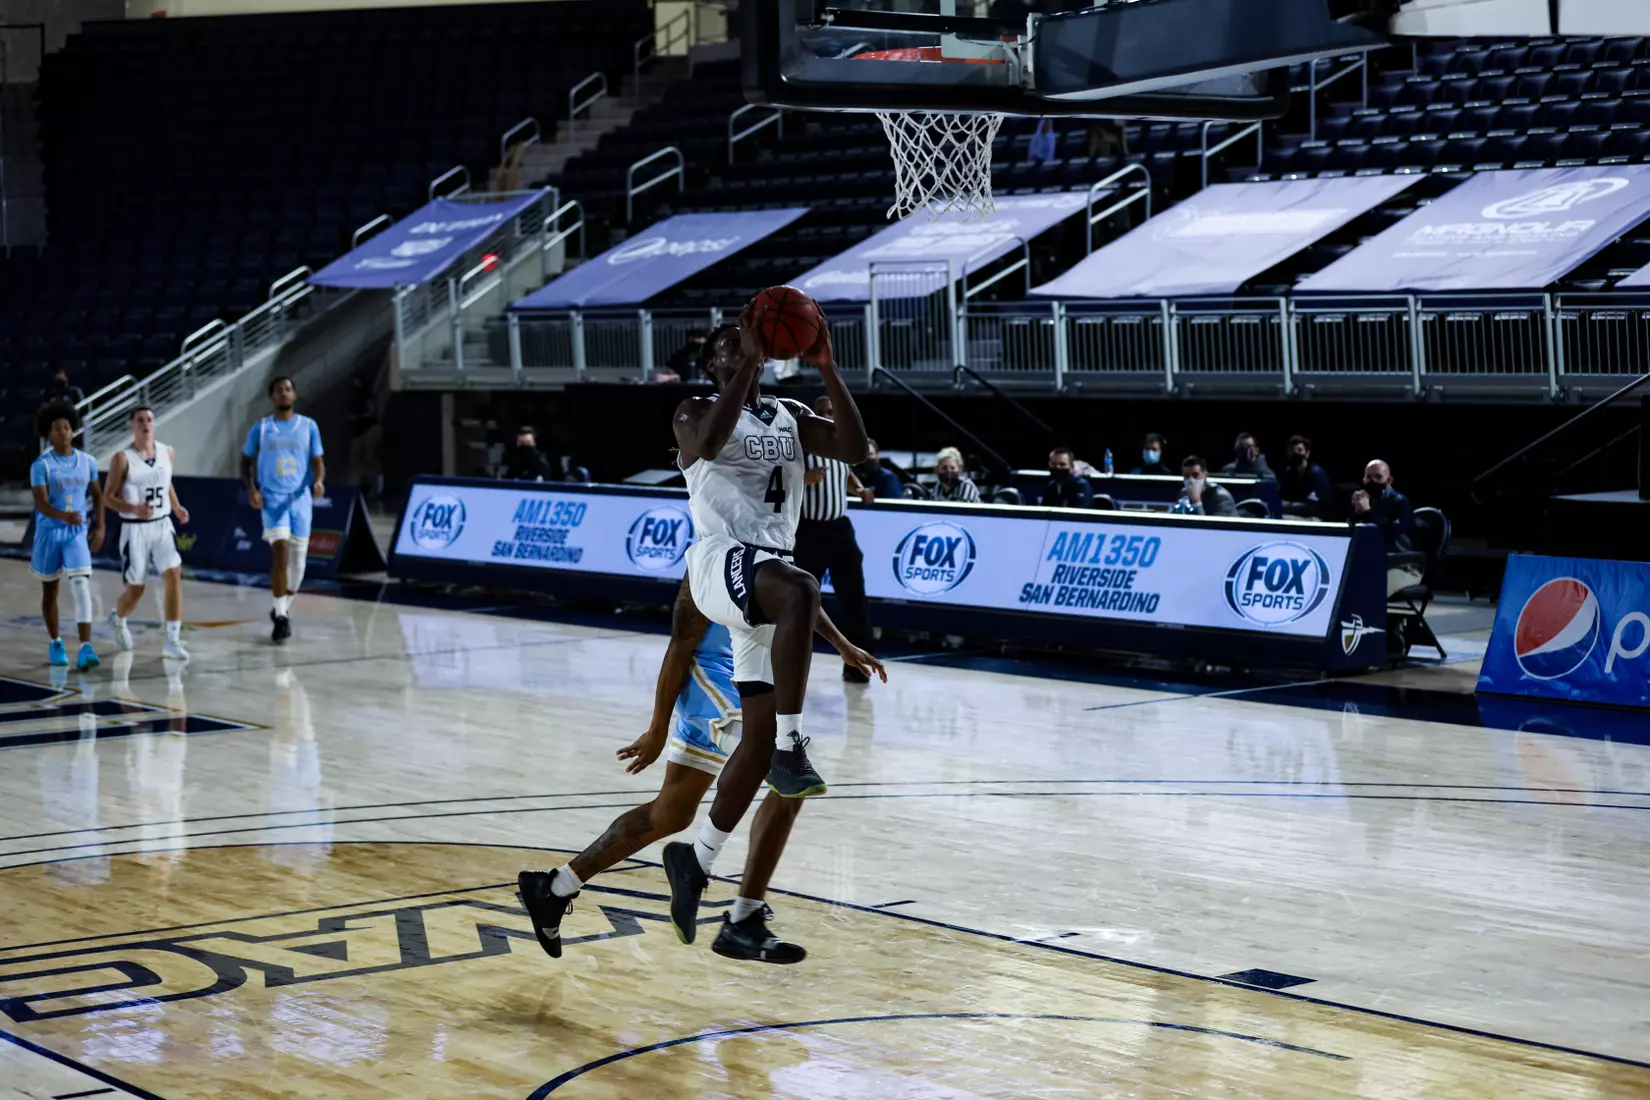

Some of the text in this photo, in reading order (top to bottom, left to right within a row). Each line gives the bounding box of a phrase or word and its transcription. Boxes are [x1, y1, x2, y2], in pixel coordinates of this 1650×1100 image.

[743, 435, 796, 461] CBU
[145, 486, 163, 508] 25
[763, 465, 786, 514] 4
[421, 502, 458, 530] FOX
[511, 498, 588, 527] AM1350
[417, 527, 451, 542] SPORTS
[513, 524, 570, 545] RIVERSIDE
[639, 516, 684, 548] FOX
[490, 540, 584, 565] SAN BERNARDINO
[635, 545, 676, 560] SPORTS
[908, 533, 963, 569] FOX
[1046, 531, 1162, 569] AM1350
[730, 549, 747, 599] LANCERS
[903, 566, 956, 582] SPORTS
[1051, 563, 1138, 590] RIVERSIDE
[1244, 555, 1312, 595] FOX
[1018, 582, 1161, 614] SAN BERNARDINO
[1240, 592, 1305, 611] SPORTS
